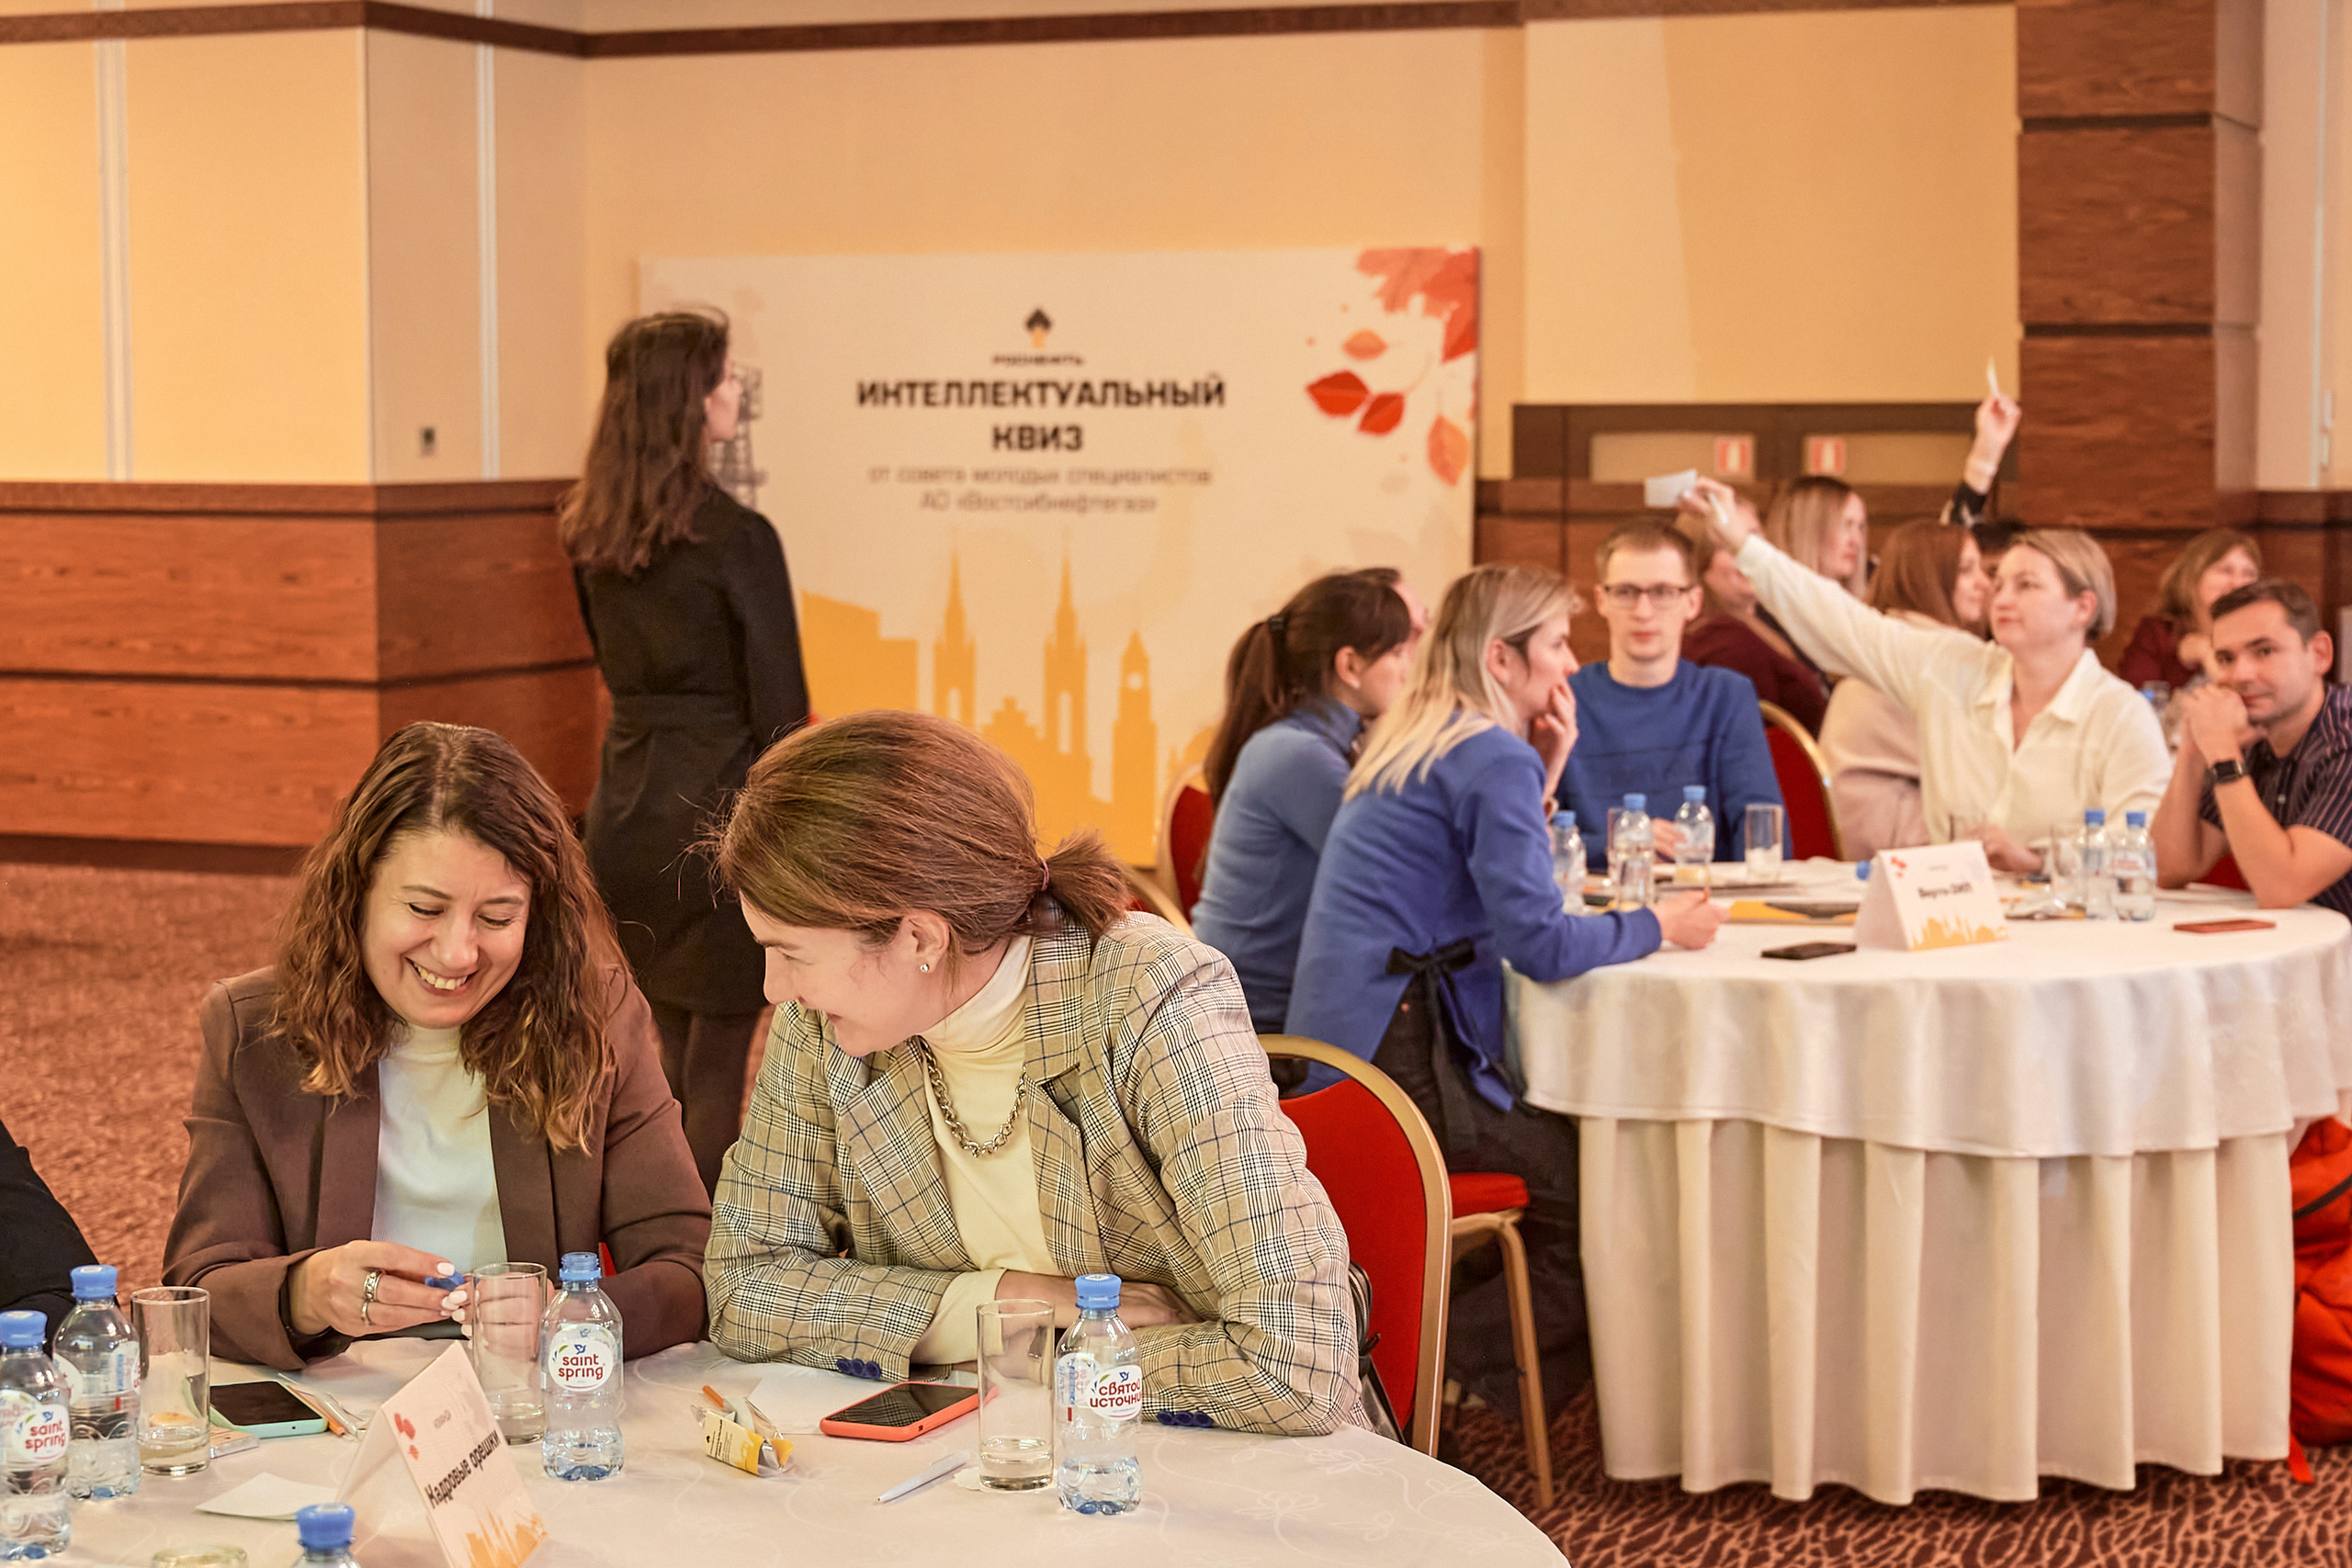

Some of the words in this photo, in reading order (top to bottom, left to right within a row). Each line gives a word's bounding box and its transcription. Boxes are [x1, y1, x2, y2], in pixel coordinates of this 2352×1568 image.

[856, 372, 1226, 408] ИНТЕЛЛЕКТУАЛЬНЫЙ
[991, 424, 1084, 452] КВИЗ
[868, 468, 890, 484] от
[898, 468, 967, 484] совета
[562, 1353, 599, 1367] saint
[558, 1366, 604, 1382] spring
[30, 1418, 63, 1437] saint
[424, 1459, 472, 1509] Кадровые
[469, 1430, 502, 1472] орешки
